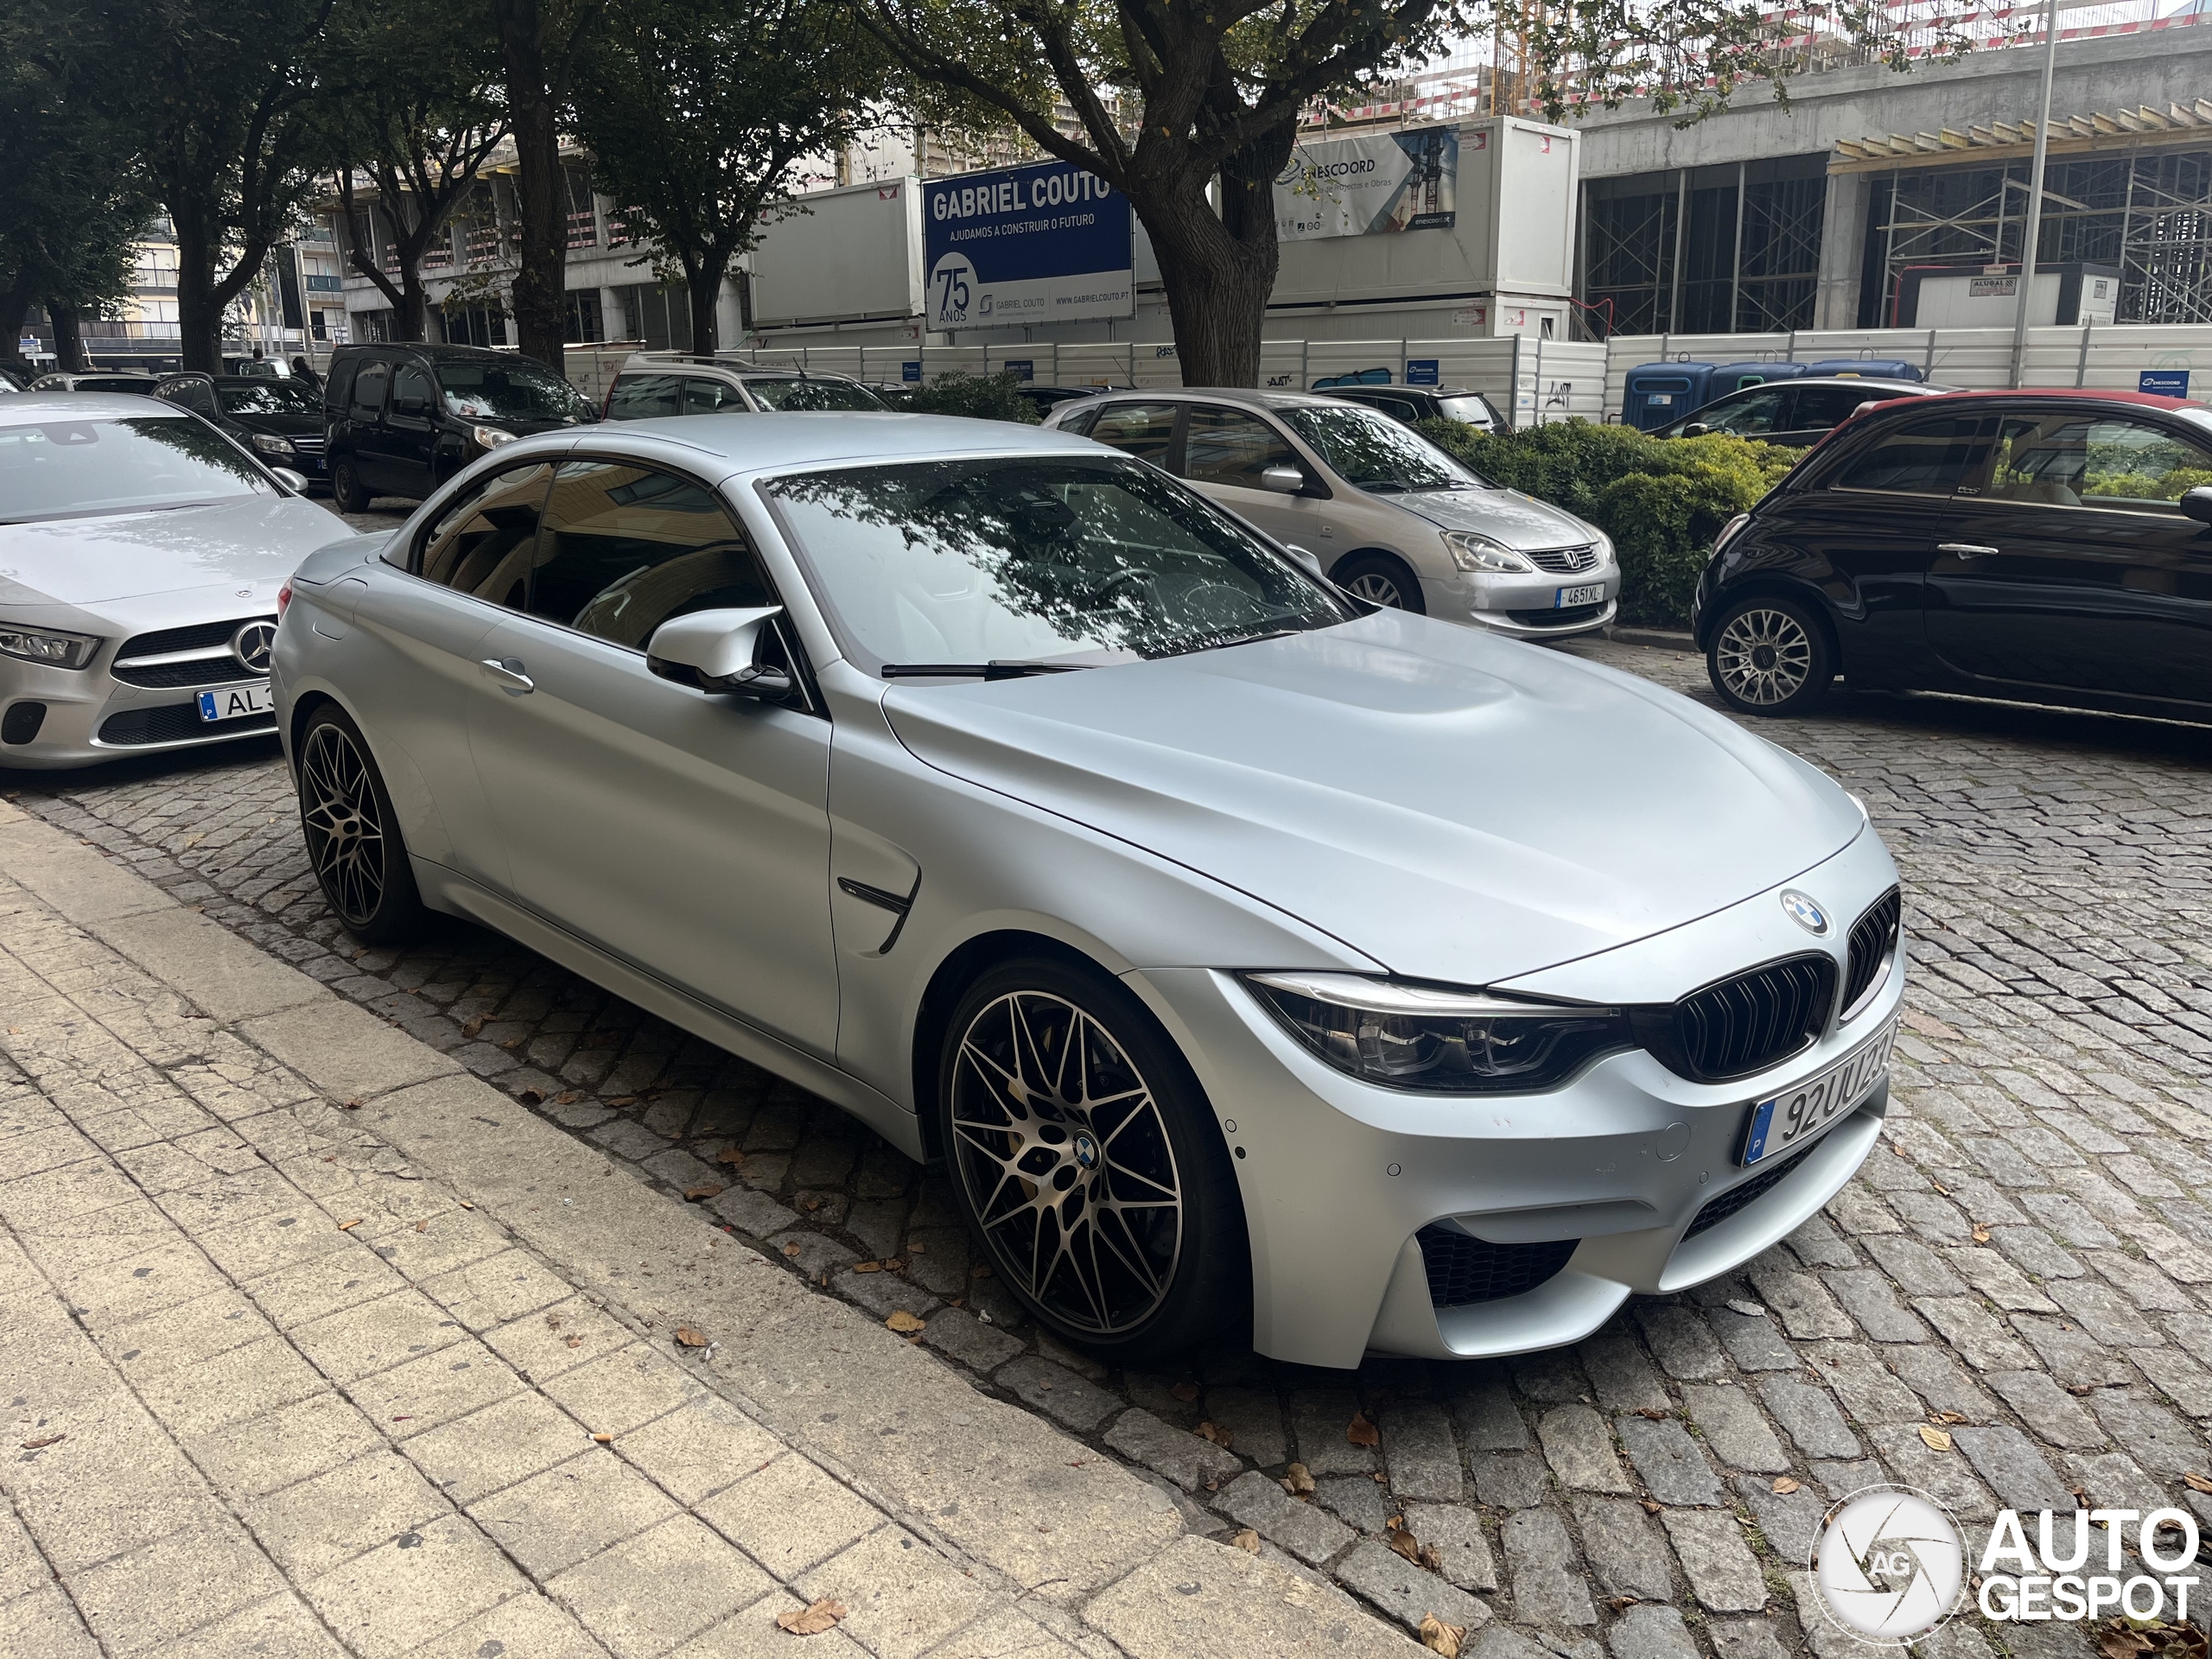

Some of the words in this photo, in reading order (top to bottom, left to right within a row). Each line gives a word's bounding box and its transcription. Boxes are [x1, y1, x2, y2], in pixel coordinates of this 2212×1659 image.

[1370, 179, 1392, 188] Obras
[933, 181, 1027, 221] GABRIEL
[1032, 170, 1110, 208] COUTO
[950, 226, 993, 241] AJUDAMOS
[994, 225, 1001, 236] A
[1001, 219, 1049, 235] CONSTRUIR
[1051, 218, 1057, 230] O
[1059, 213, 1095, 228] FUTURO
[937, 267, 969, 311] 75
[996, 300, 1021, 309] GABRIEL
[1023, 298, 1045, 308] COUTO
[1056, 291, 1129, 305] WWW.GABRIELCOUTO.PT
[939, 309, 967, 323] ANOS
[1568, 588, 1597, 603] 4651XL
[1752, 1138, 1761, 1154] P
[1783, 1032, 1889, 1141] 92UU23
